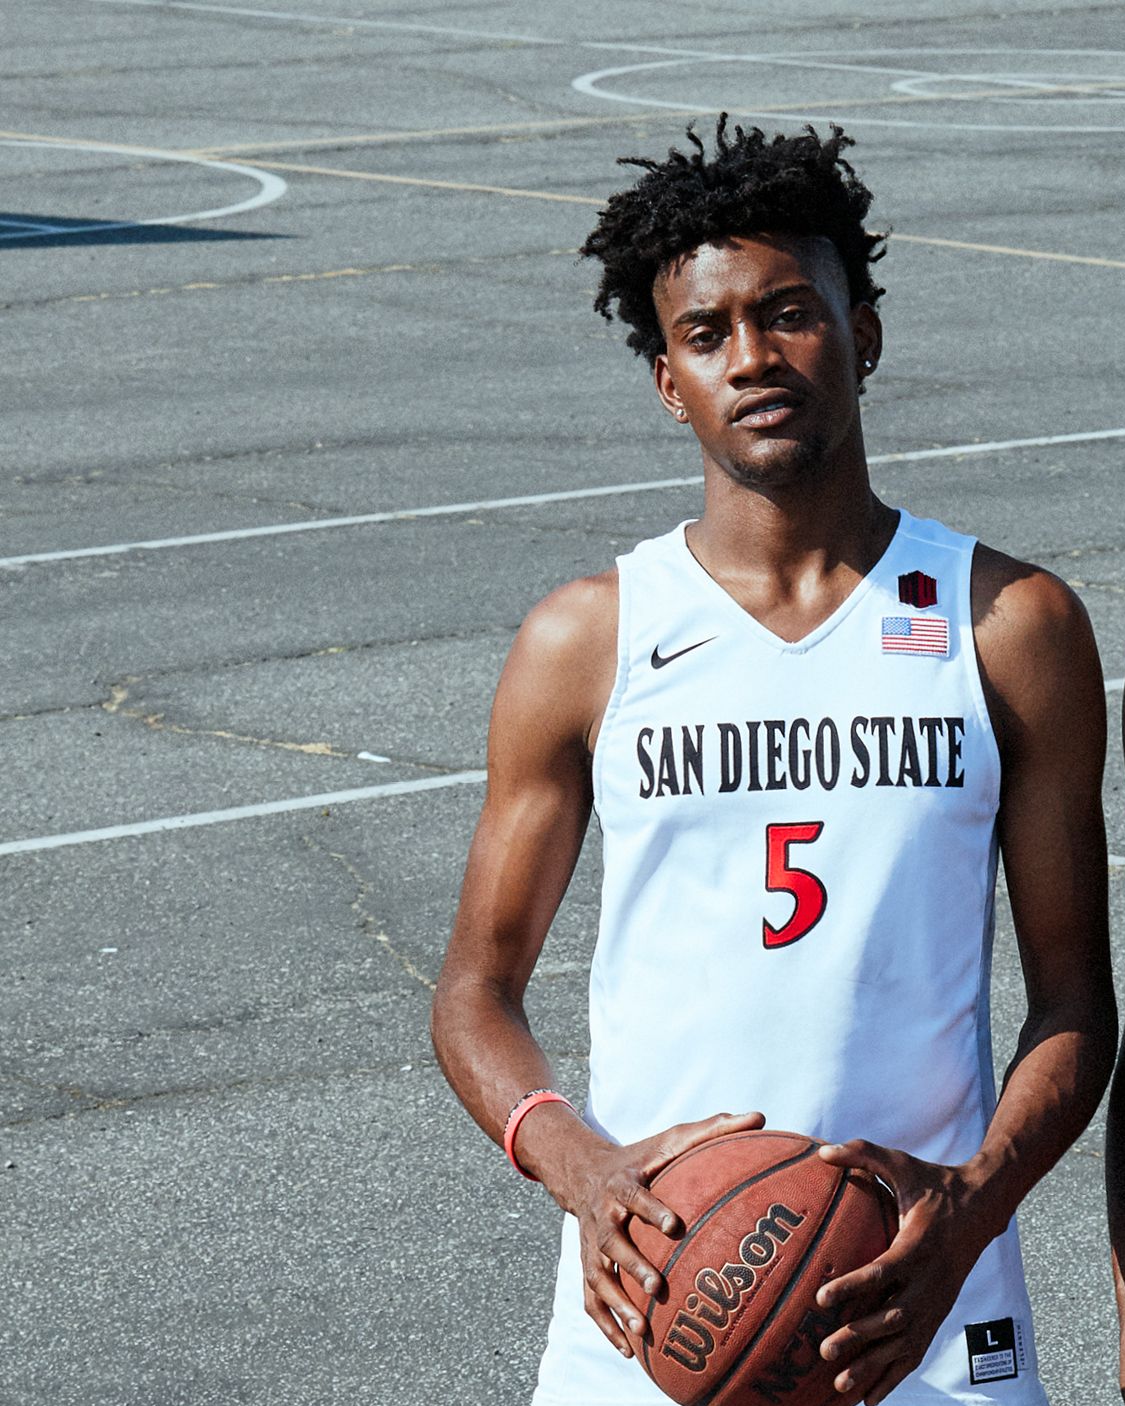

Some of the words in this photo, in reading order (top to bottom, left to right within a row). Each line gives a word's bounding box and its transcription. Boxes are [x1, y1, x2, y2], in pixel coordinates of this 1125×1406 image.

[637, 724, 704, 799] SAN
[717, 717, 840, 792] DIEGO
[850, 715, 965, 788] STATE
[762, 821, 828, 949] 5
[658, 1202, 806, 1374] Wilson
[986, 1329, 999, 1347] L
